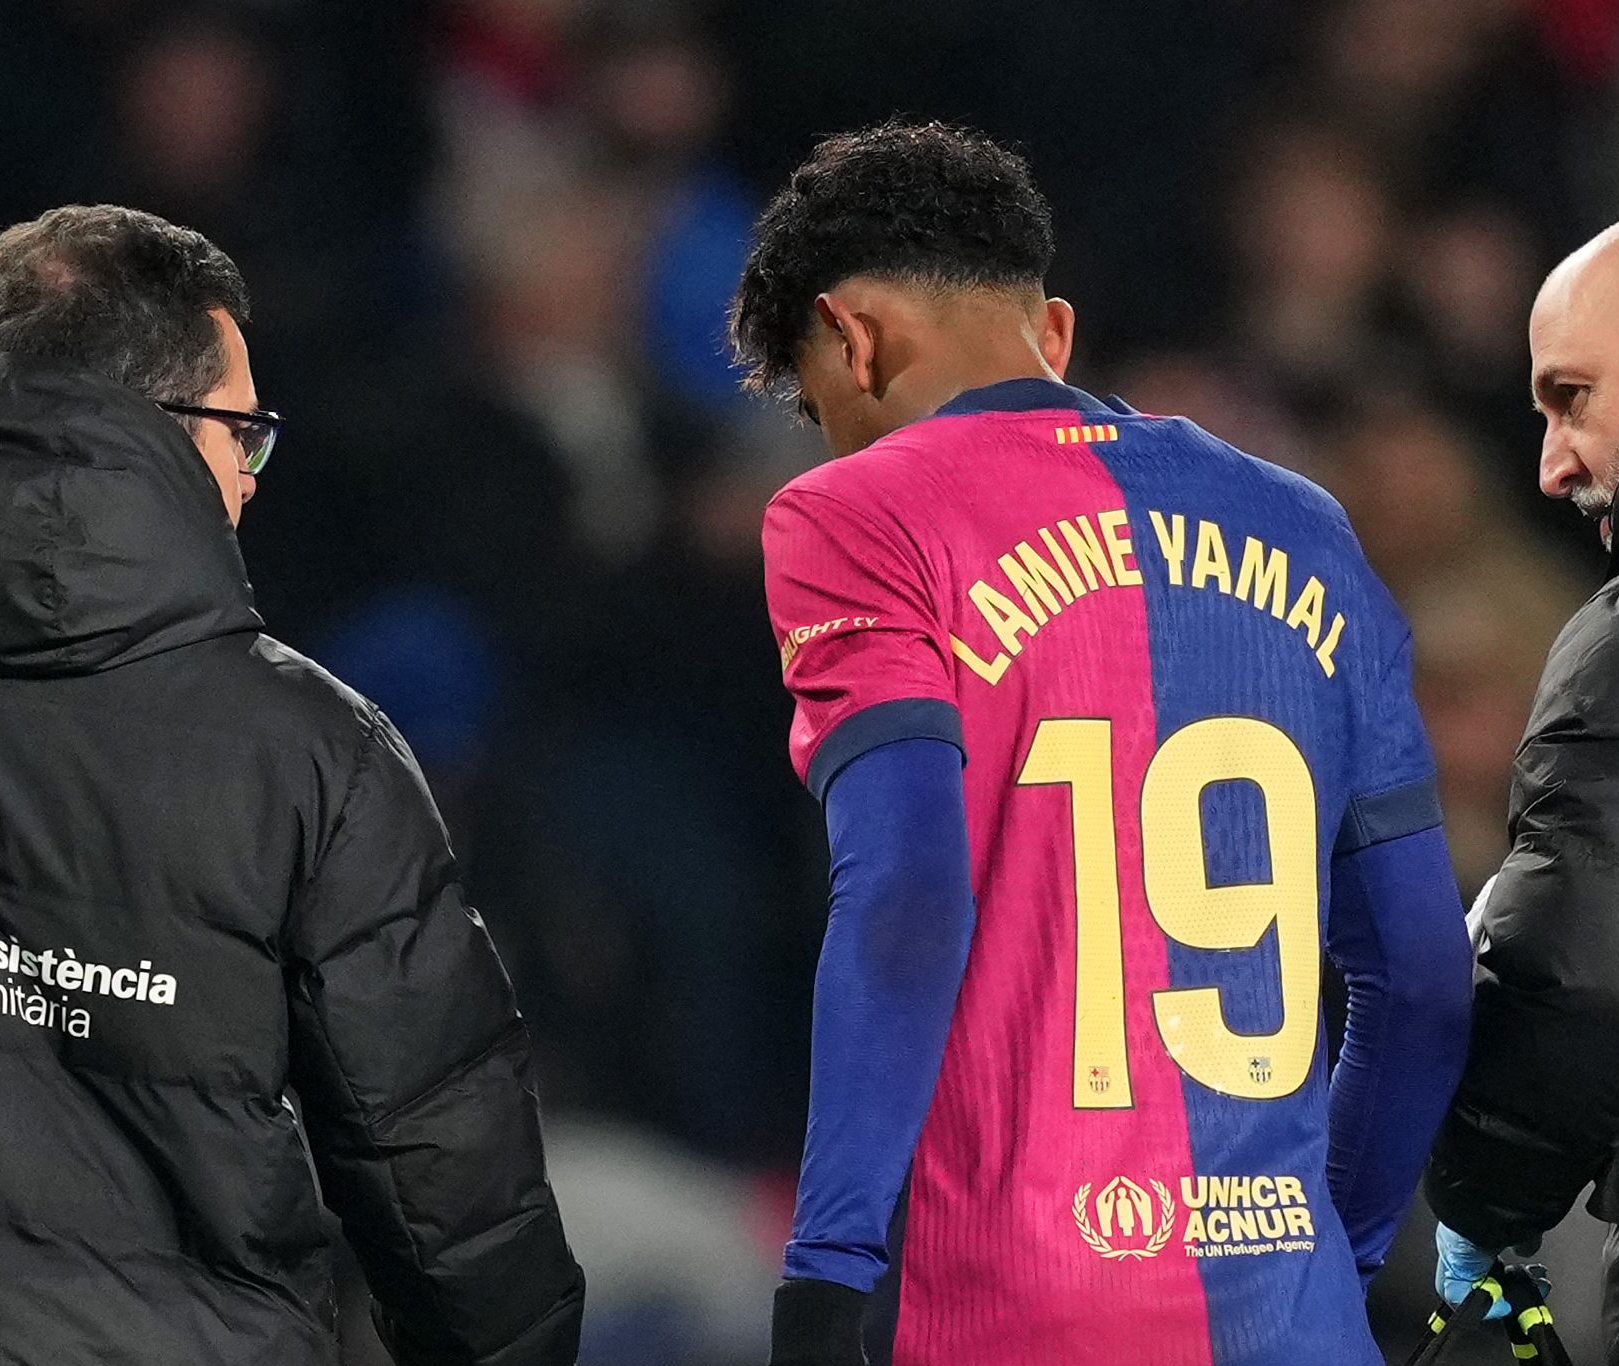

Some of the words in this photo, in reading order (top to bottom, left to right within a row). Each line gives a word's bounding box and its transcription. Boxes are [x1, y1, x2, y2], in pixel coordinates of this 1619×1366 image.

[949, 509, 1144, 686] LAMINE
[1148, 510, 1345, 679] YAMAL
[1017, 716, 1321, 1109] 19
[1180, 1176, 1307, 1208] UNHCR
[1183, 1208, 1314, 1242] ACNUR
[1185, 1245, 1203, 1257] The
[1205, 1245, 1223, 1256] UN
[1224, 1242, 1274, 1256] Refugee
[1276, 1240, 1315, 1252] Agency
